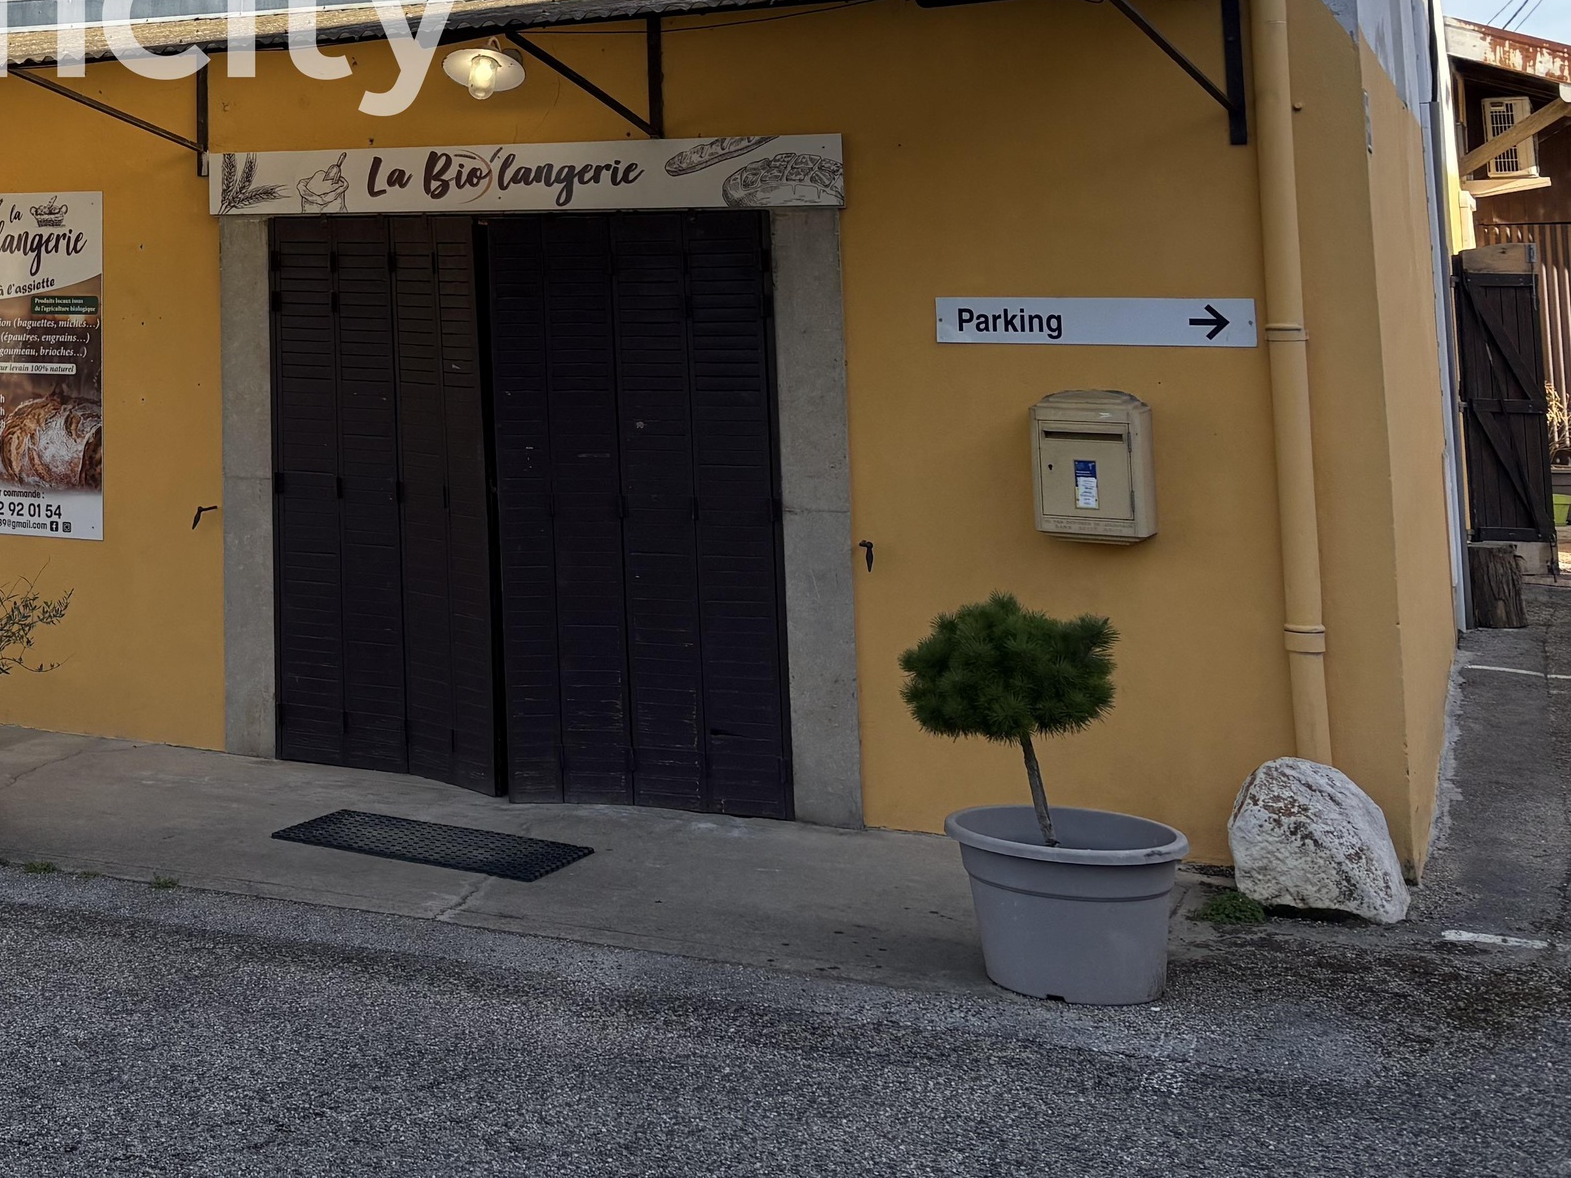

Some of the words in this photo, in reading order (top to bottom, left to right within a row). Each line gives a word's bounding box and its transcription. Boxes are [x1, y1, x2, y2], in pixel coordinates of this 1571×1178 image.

[367, 156, 413, 197] La
[10, 204, 23, 223] la
[7, 277, 55, 295] l'assiette
[958, 308, 1063, 340] Parking
[4, 489, 40, 498] commande
[8, 502, 24, 516] 92
[28, 503, 40, 517] 01
[45, 504, 62, 519] 54
